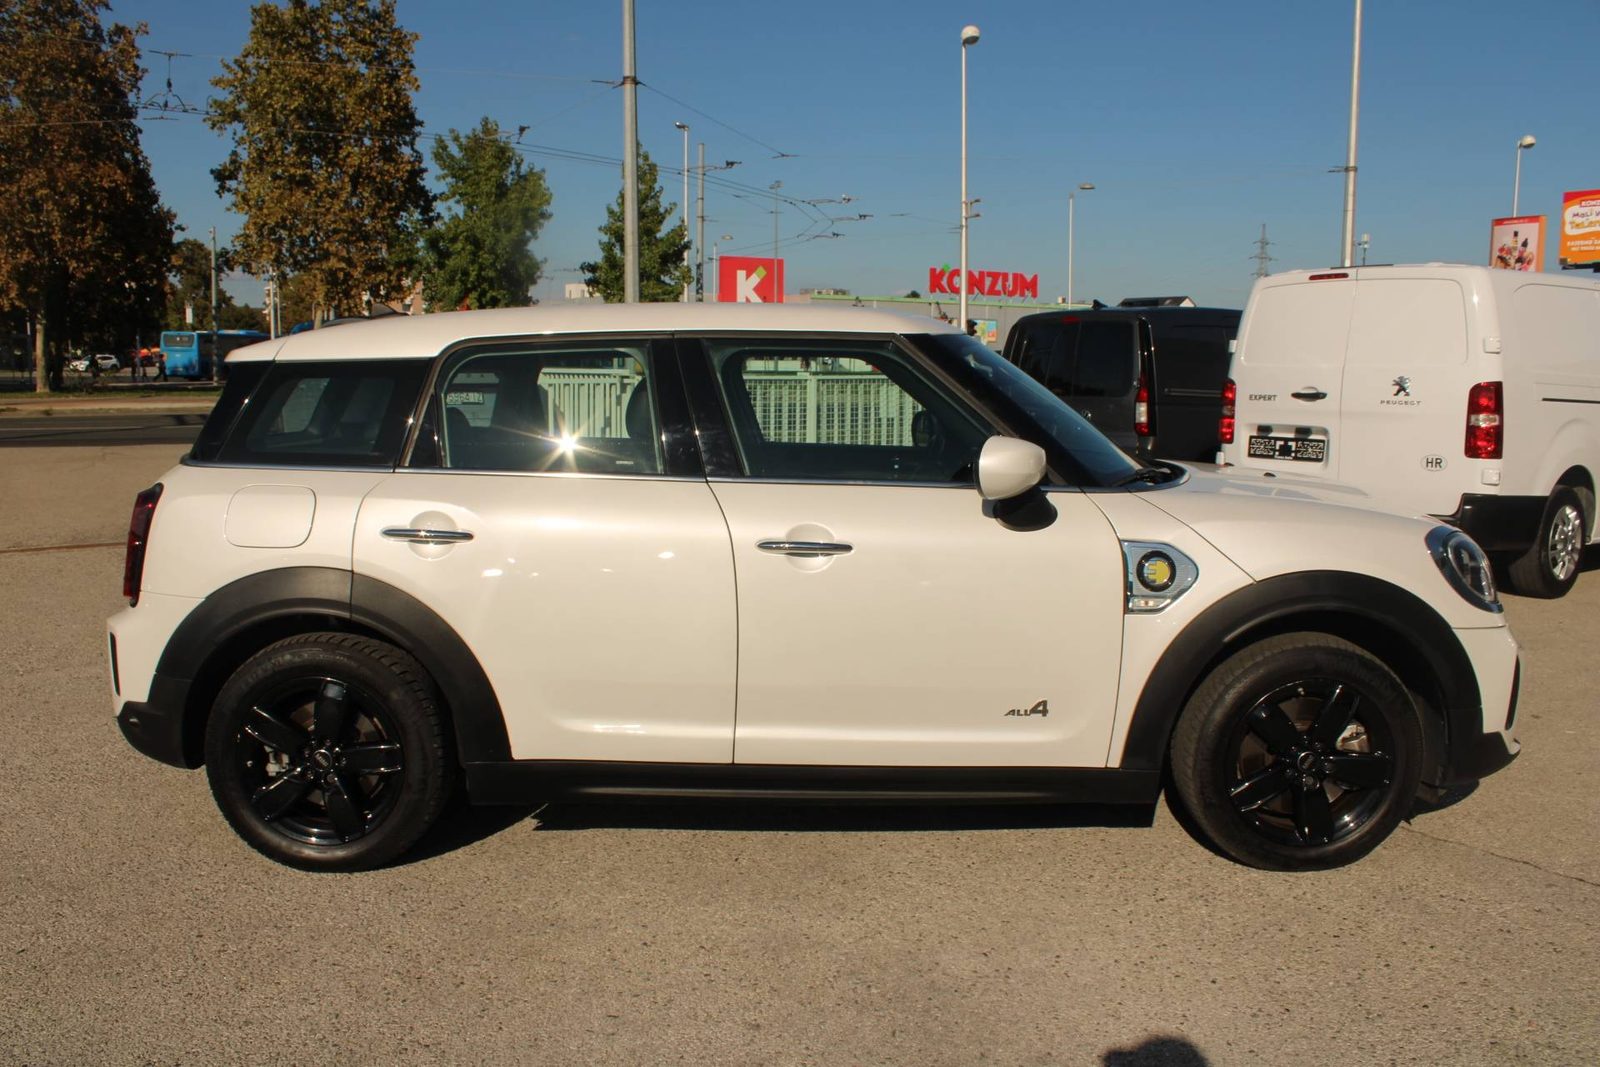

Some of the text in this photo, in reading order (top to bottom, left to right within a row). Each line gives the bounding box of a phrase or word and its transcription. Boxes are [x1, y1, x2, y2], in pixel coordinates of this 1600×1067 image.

[736, 266, 767, 302] K
[929, 264, 1038, 299] KONZUM
[1249, 394, 1278, 402] EXPERT
[1426, 457, 1443, 469] HR
[1004, 700, 1049, 717] ALL4
